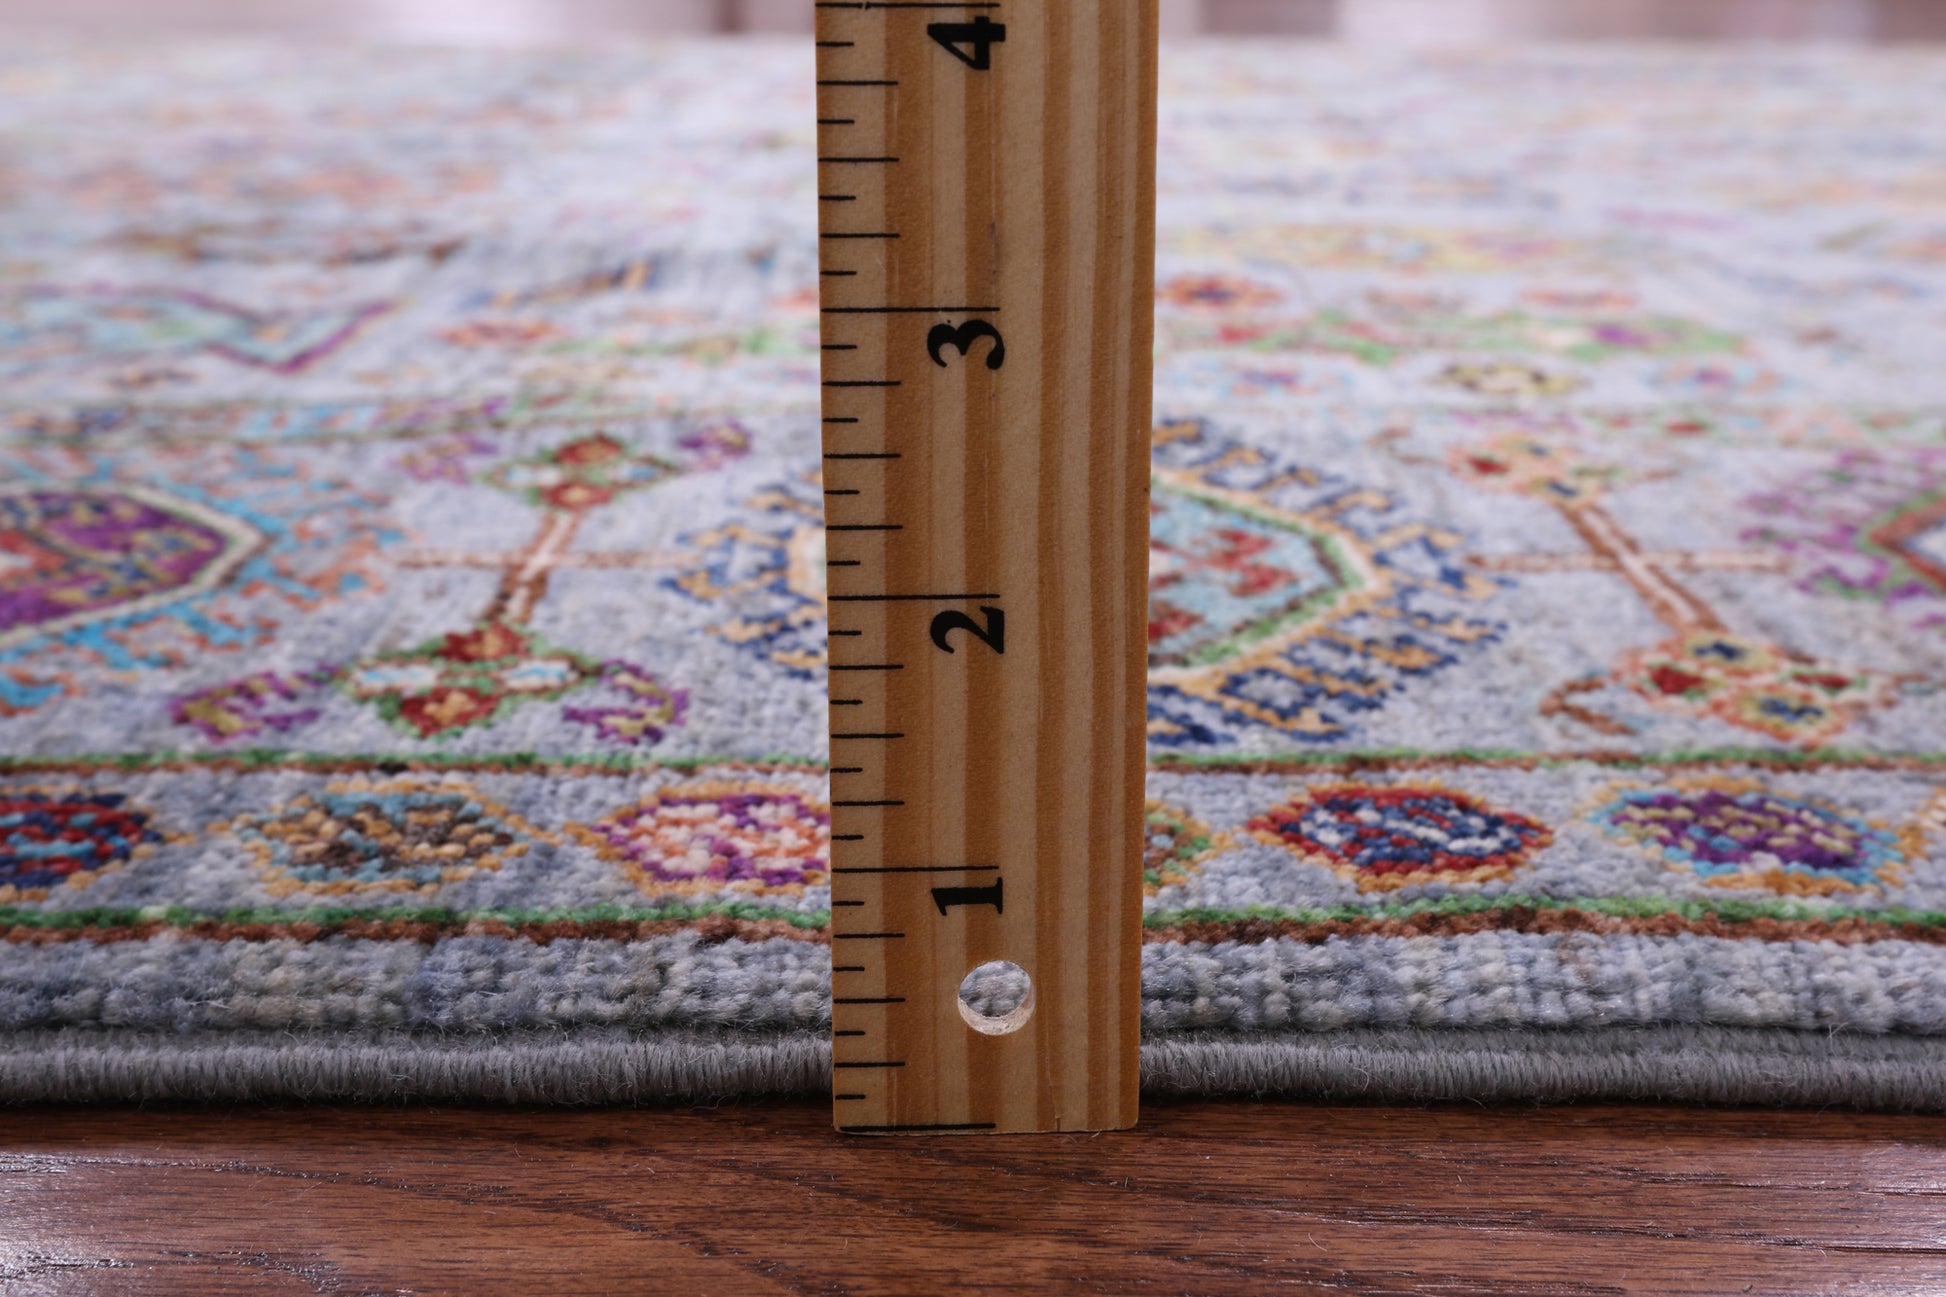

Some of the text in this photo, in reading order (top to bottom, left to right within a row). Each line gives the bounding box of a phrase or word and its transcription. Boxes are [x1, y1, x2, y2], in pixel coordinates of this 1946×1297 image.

[927, 16, 1006, 70] 4
[927, 319, 1005, 370] 3
[930, 605, 1005, 655] 2
[931, 876, 1004, 916] 1
